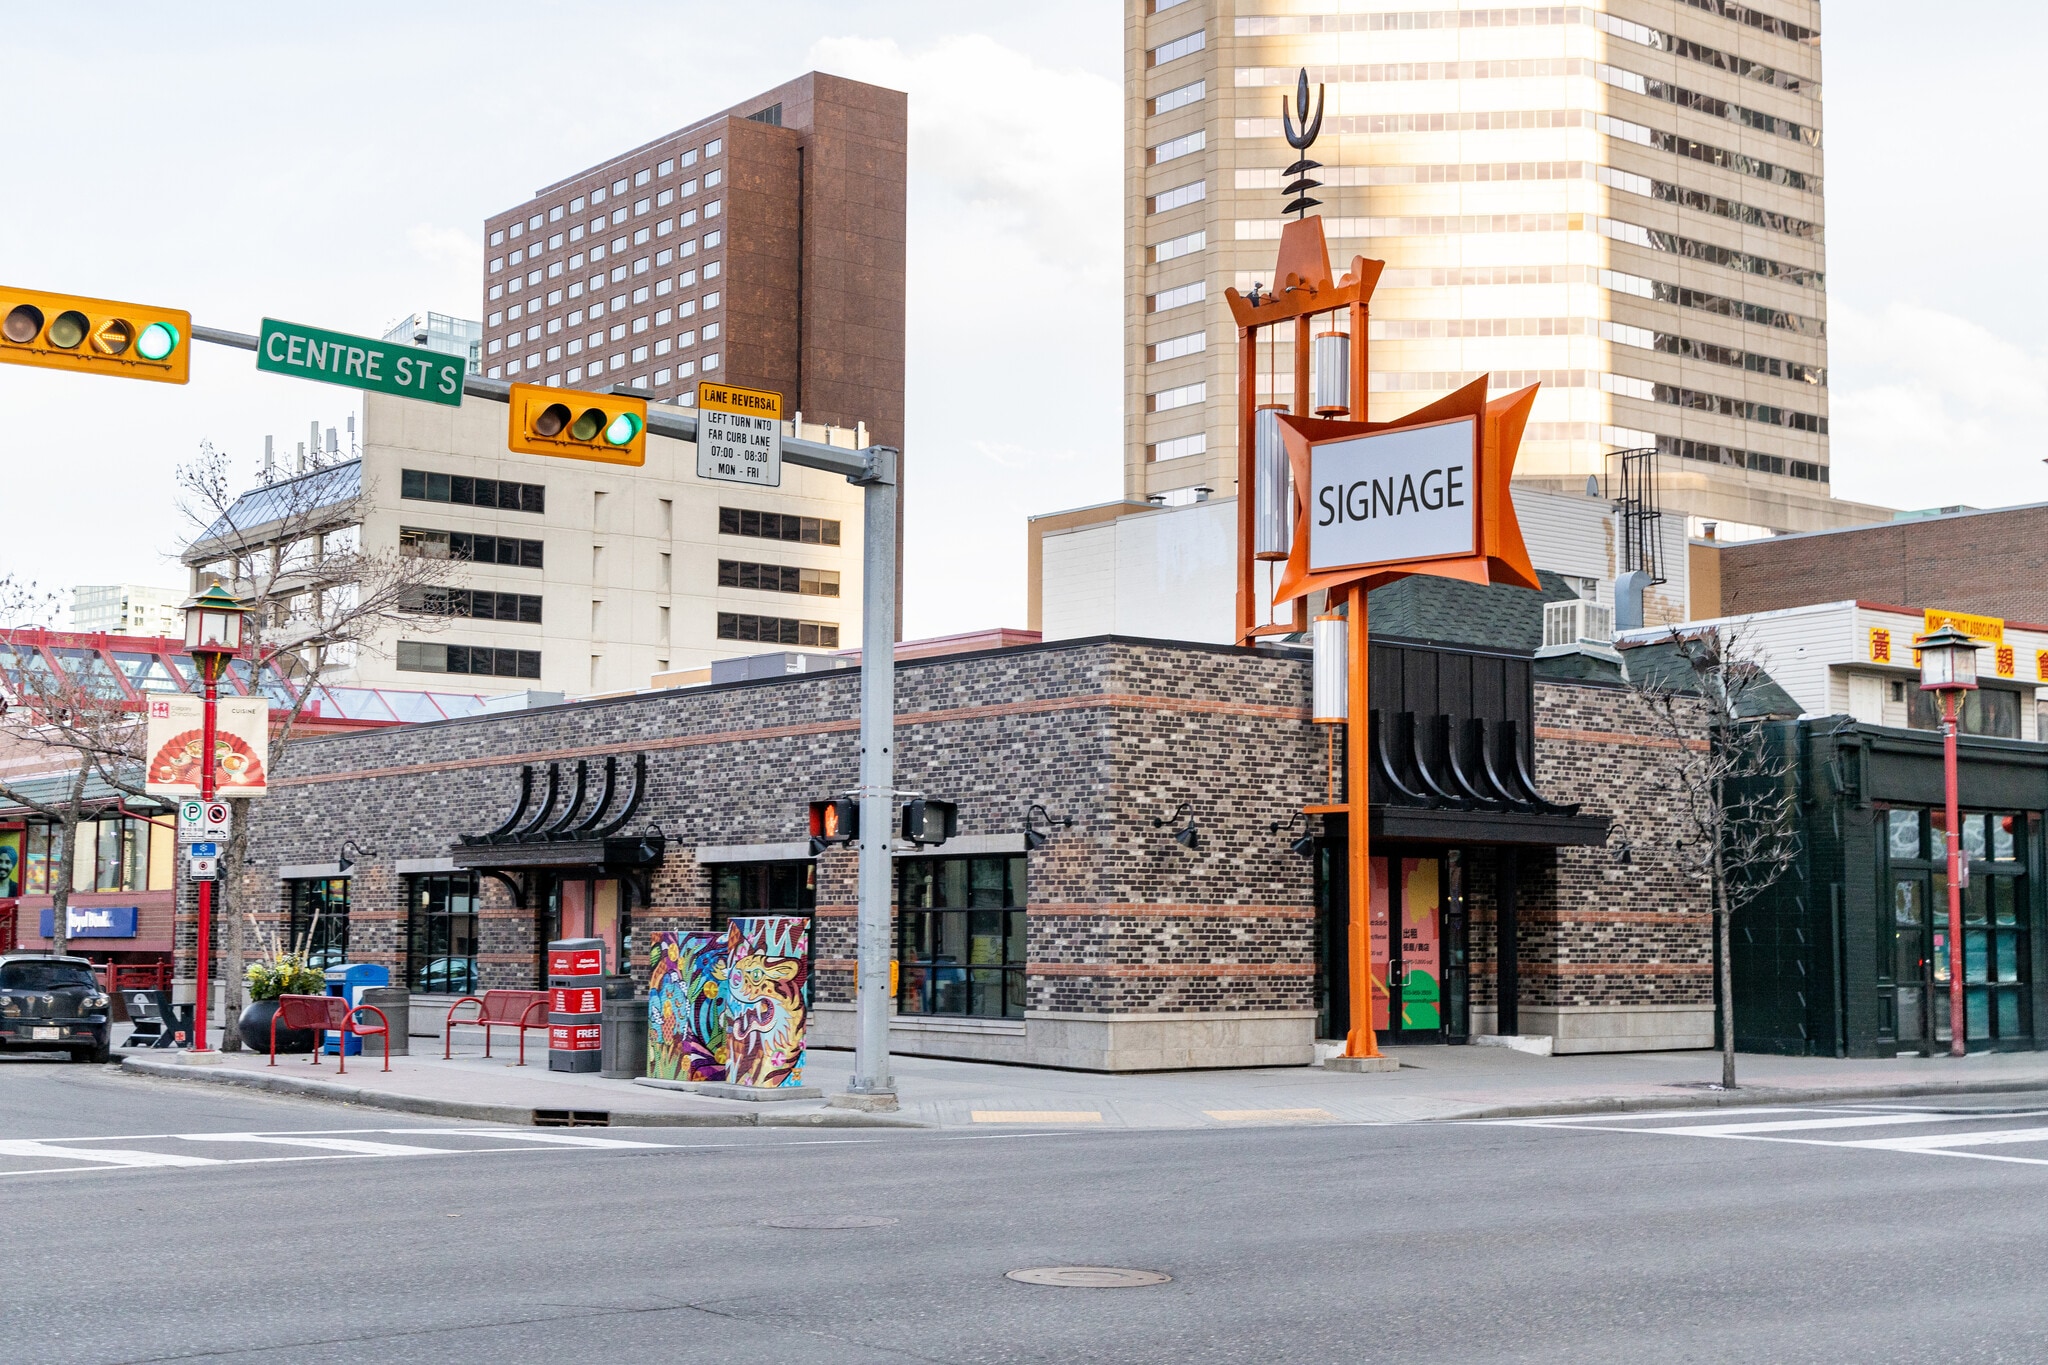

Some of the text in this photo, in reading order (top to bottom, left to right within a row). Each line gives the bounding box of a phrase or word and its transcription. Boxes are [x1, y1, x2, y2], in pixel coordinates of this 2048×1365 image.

[266, 332, 457, 394] CENTRE ST S
[704, 389, 776, 411] LANE REVERSAL
[708, 412, 772, 431] LEFT TURN INTO
[708, 429, 770, 447] FAR CURB LANE
[712, 446, 733, 458] 07:00
[745, 450, 767, 462] 08:30
[718, 463, 736, 475] MON
[747, 467, 759, 478] FRI
[1318, 466, 1464, 526] SIGNAGE
[189, 806, 198, 817] P
[553, 1028, 568, 1038] FREE
[576, 1028, 599, 1038] FREE
